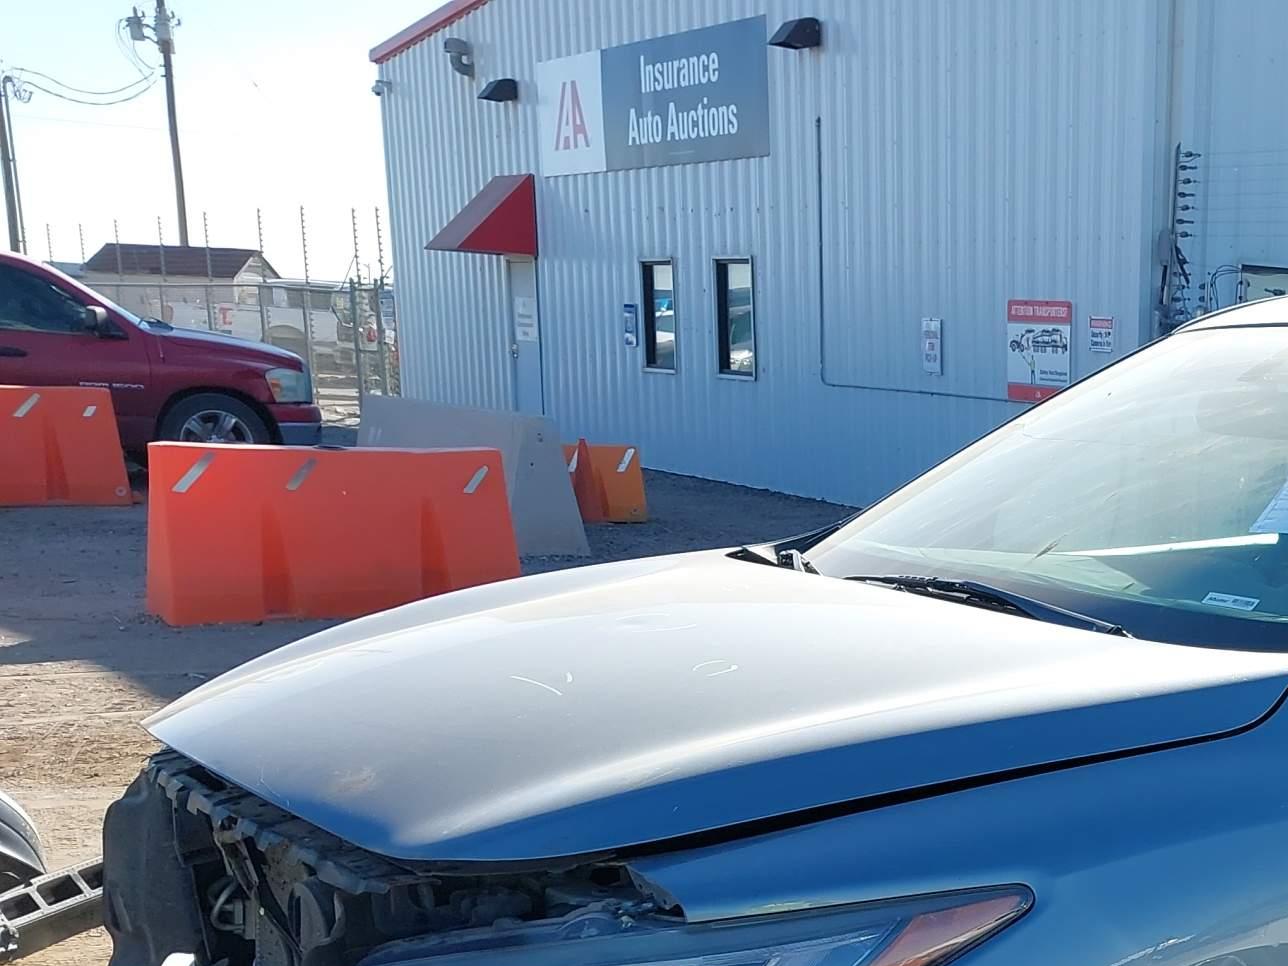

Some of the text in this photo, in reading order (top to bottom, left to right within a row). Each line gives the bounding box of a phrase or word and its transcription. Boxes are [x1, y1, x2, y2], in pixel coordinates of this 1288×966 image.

[639, 52, 720, 94] Insurance
[627, 97, 738, 146] Auto Auctions
